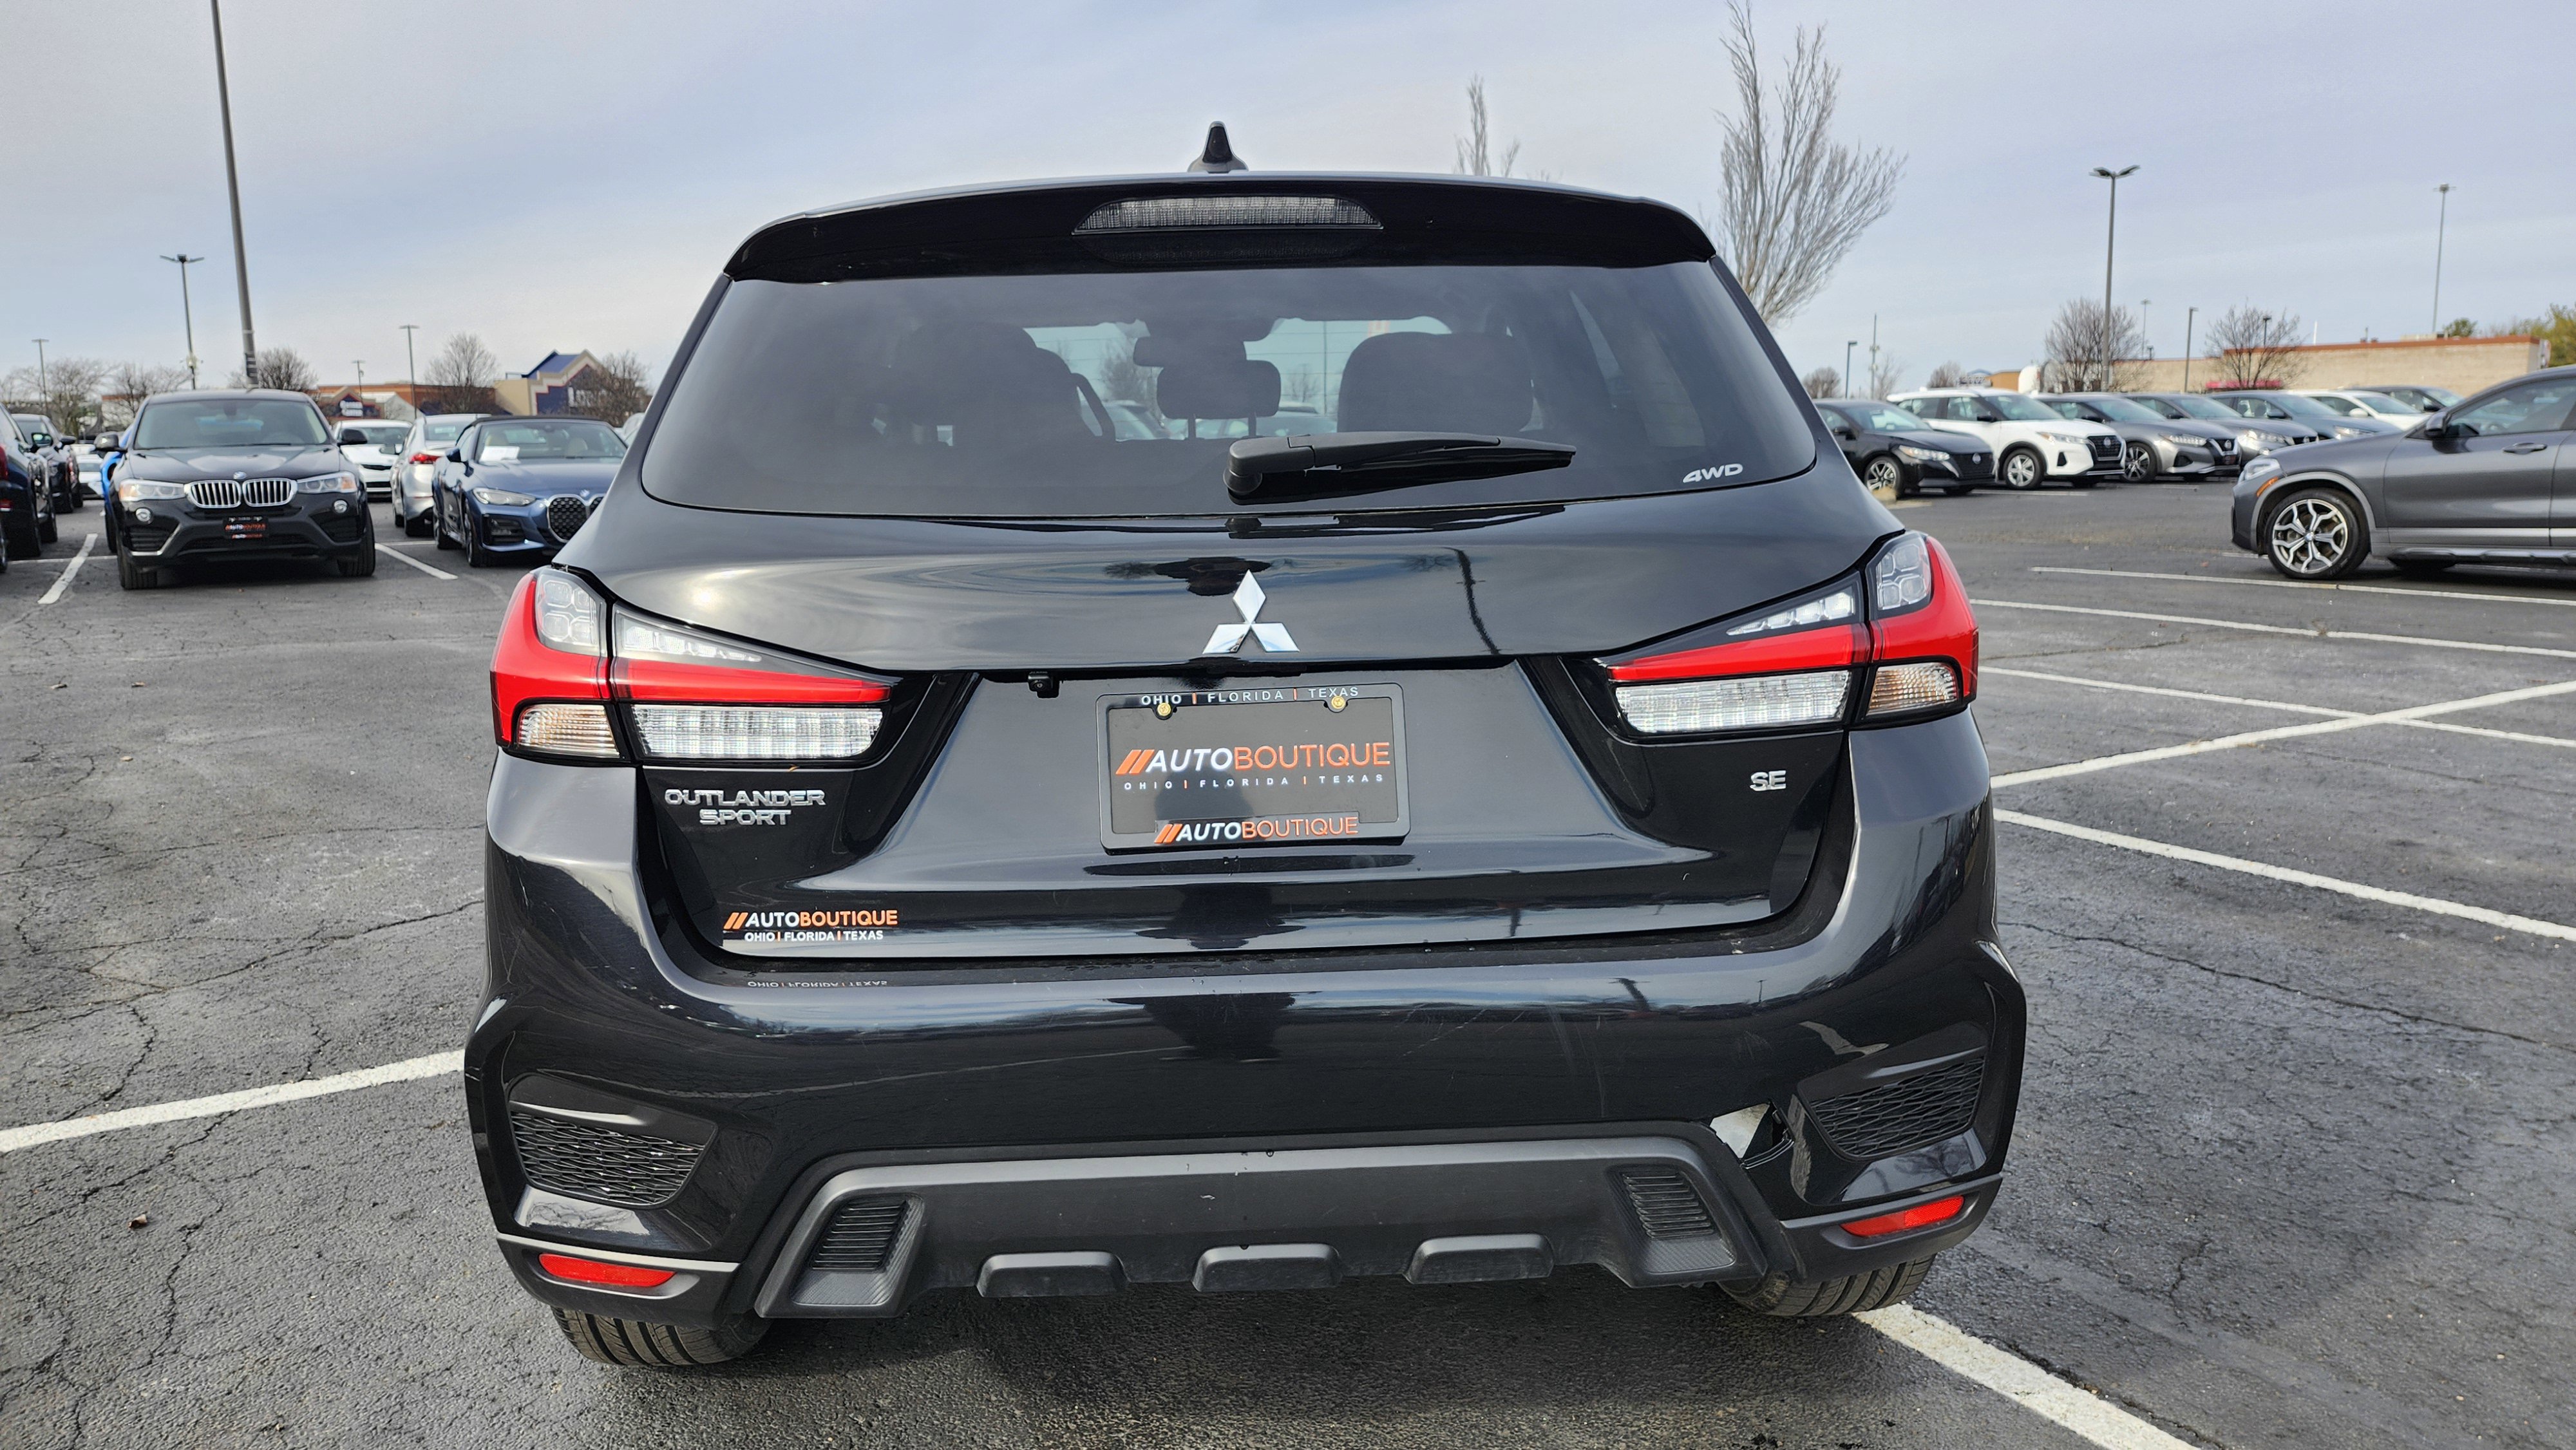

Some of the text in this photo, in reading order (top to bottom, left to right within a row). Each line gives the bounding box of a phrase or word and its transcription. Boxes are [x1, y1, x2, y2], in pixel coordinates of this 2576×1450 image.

[1682, 463, 1743, 483] 4WD
[1141, 686, 1359, 706] OHIO FLORIDA TEXAS
[1145, 742, 1391, 773] AUTOBOUTIQUE
[1124, 774, 1383, 791] OHIO FLORIDA TEXAS
[1749, 769, 1786, 792] SE
[664, 789, 827, 807] OUTLANDER
[699, 809, 792, 826] SPORT
[1176, 816, 1359, 842] AUTOBOUTIQUE
[744, 909, 898, 928] AUTOBOUTIQUE
[744, 930, 884, 943] OHIO FLORIDA TEXAS
